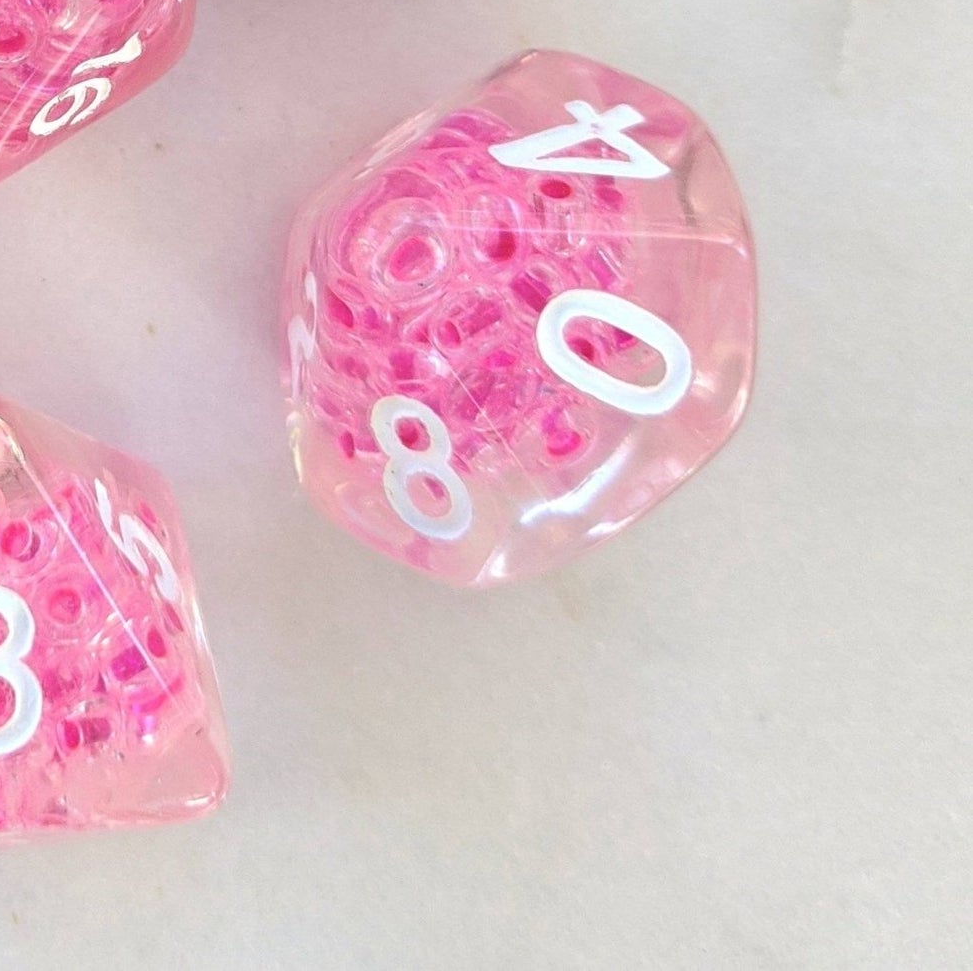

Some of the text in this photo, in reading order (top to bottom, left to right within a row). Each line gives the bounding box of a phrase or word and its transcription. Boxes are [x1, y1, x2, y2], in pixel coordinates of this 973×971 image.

[29, 32, 144, 137] 16
[487, 98, 673, 179] 4
[535, 287, 694, 416] 0
[369, 394, 474, 542] 8
